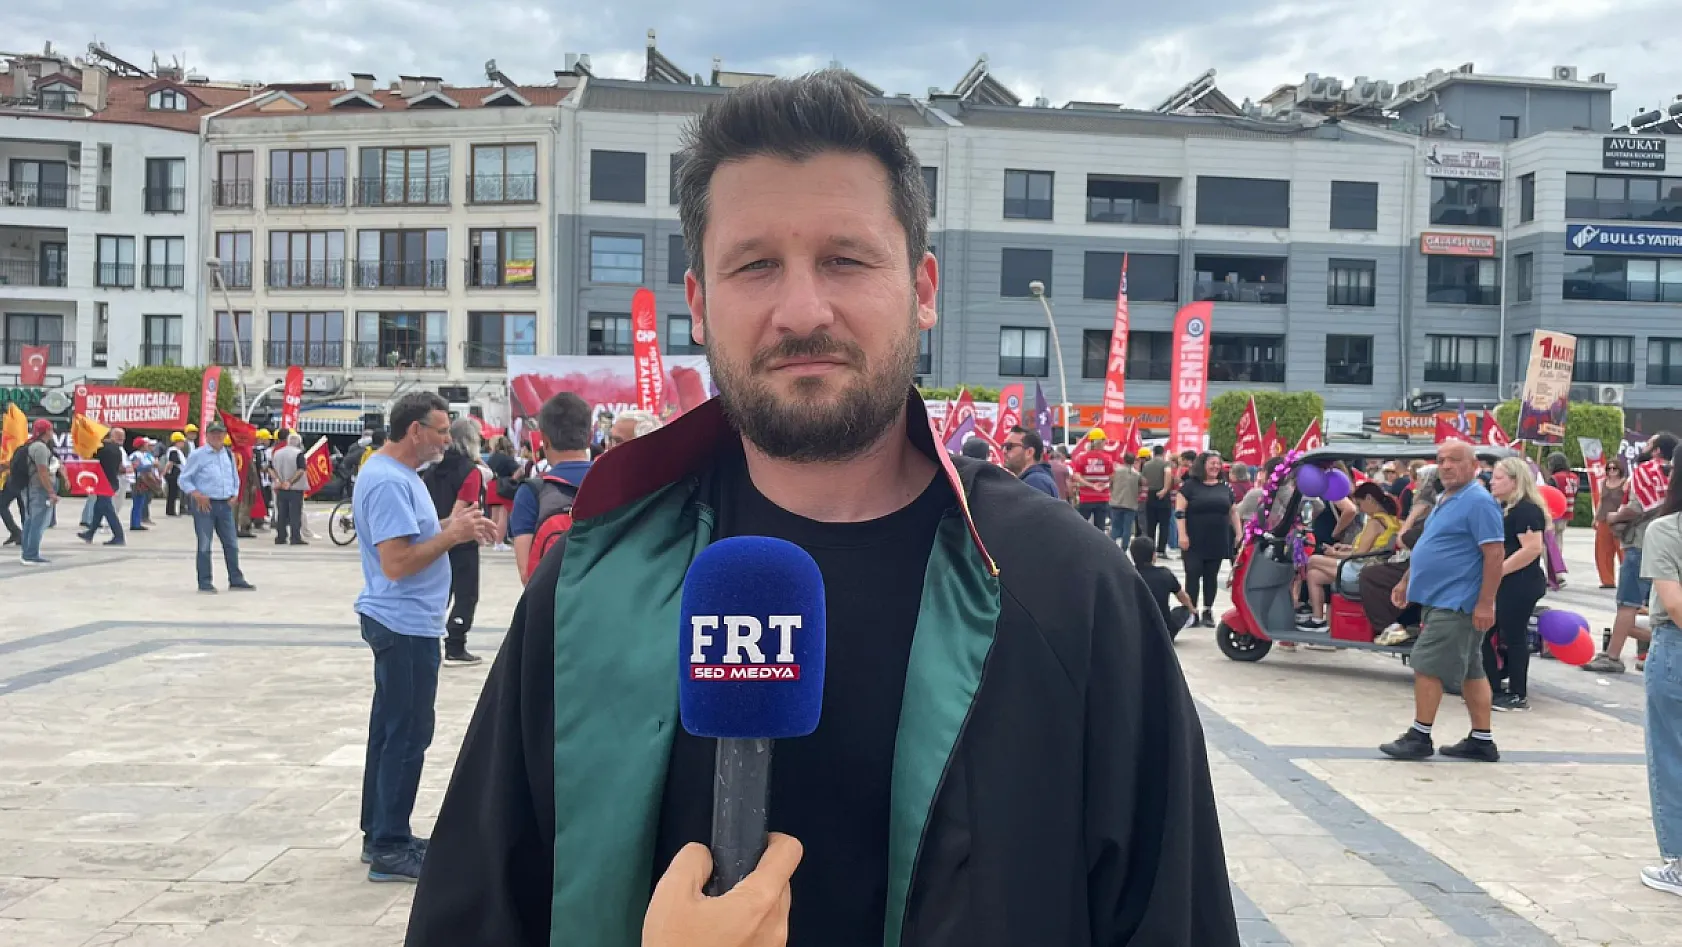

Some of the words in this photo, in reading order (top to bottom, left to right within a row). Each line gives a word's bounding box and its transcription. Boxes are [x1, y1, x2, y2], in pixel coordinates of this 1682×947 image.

[1609, 138, 1661, 150] AVUKAT
[1600, 232, 1645, 245] BULLS
[1540, 337, 1552, 359] 1
[690, 615, 802, 663] FRT
[694, 667, 725, 679] SED
[730, 667, 795, 679] MEDYA
